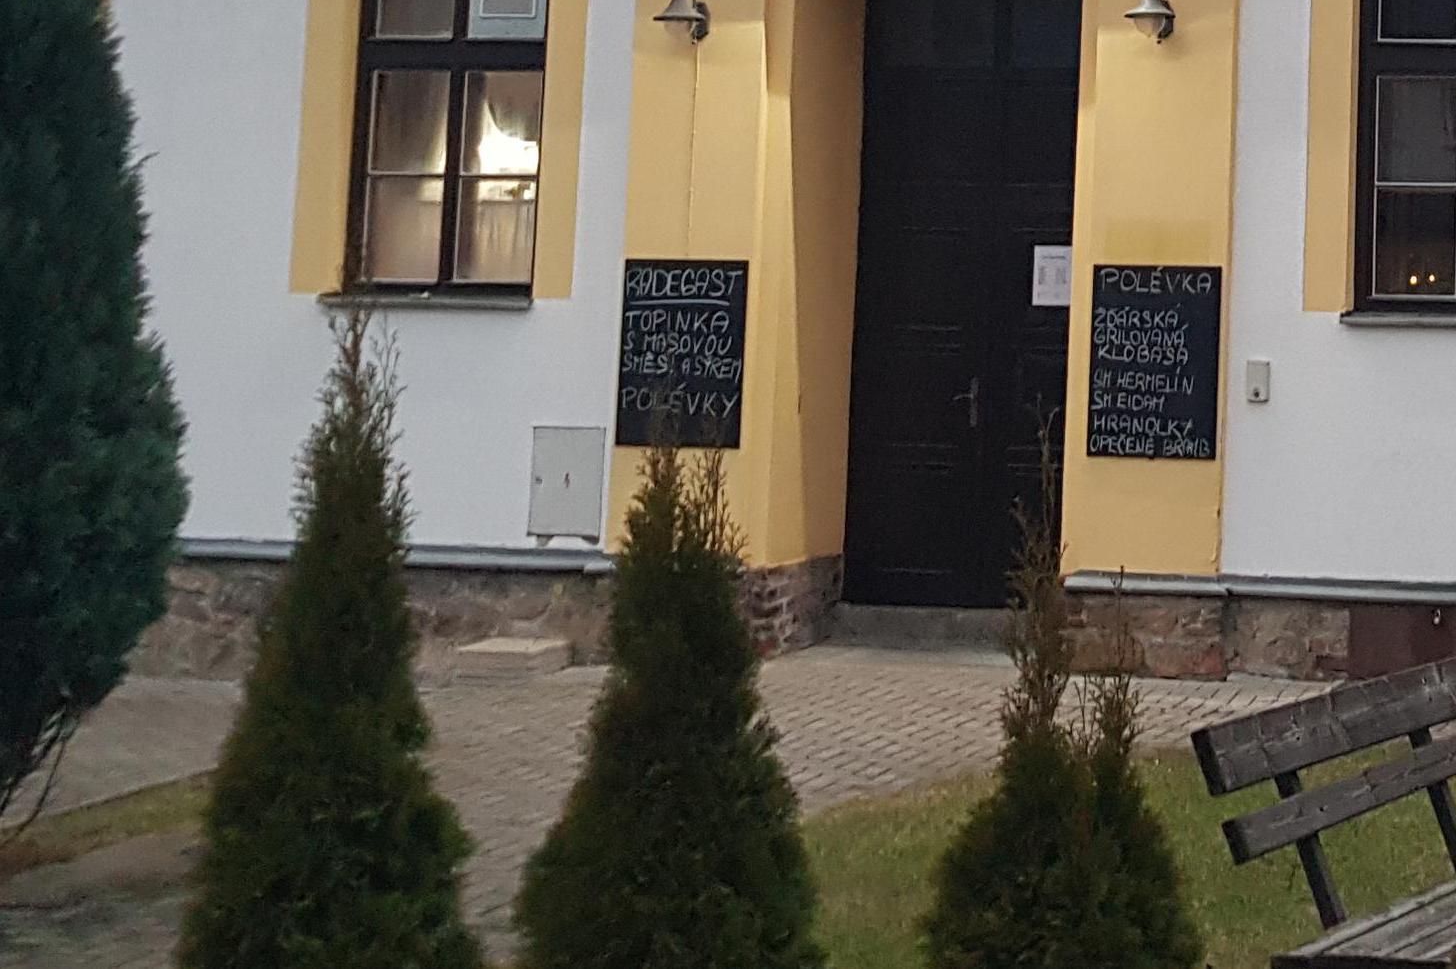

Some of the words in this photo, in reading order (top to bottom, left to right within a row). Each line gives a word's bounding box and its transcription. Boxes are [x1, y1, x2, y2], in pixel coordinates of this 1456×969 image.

[626, 267, 743, 297] RADEGAST
[1100, 267, 1212, 294] POLÉVKA
[625, 309, 729, 333] TOPINKA
[623, 332, 634, 350] S
[1094, 324, 1189, 347] GRILOVANÁ
[682, 359, 690, 374] A
[1117, 366, 1194, 395] HERMELÍN
[1117, 392, 1165, 412] EIDAM
[1094, 414, 1193, 437] HRANOLKY
